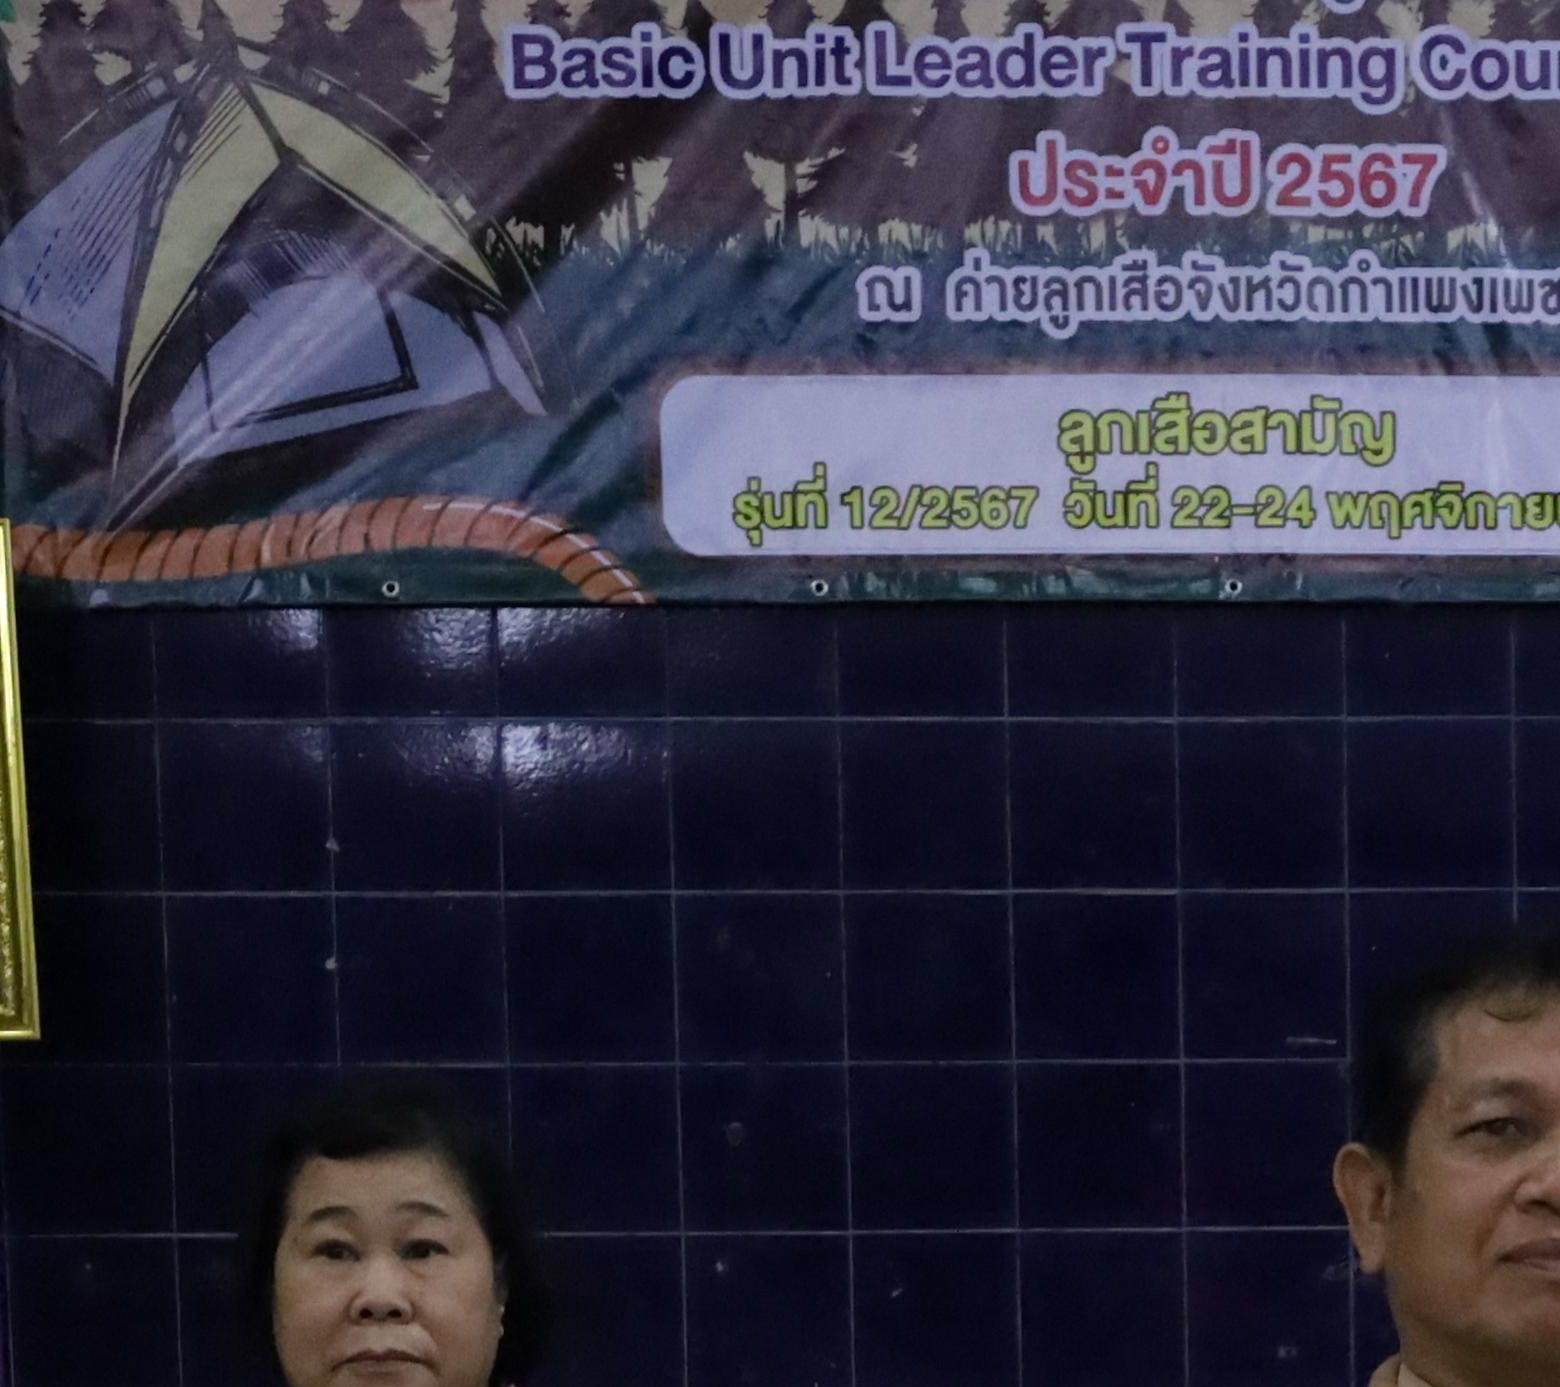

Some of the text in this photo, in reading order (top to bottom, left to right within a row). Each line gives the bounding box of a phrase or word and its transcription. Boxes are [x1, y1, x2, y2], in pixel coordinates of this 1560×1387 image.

[511, 31, 697, 90] Basic
[717, 32, 854, 90] Unit
[873, 30, 1107, 89] Leader
[1124, 31, 1396, 106] Training
[1018, 134, 1438, 207] ประจำปี 2567
[865, 274, 912, 312] ณ
[1058, 391, 1396, 474] ลูกเสือสามัญ
[732, 461, 829, 546] รุ่นที่
[840, 485, 1039, 530] 12/2567
[1063, 461, 1160, 529] วันที่
[1171, 484, 1315, 529] 22-24
